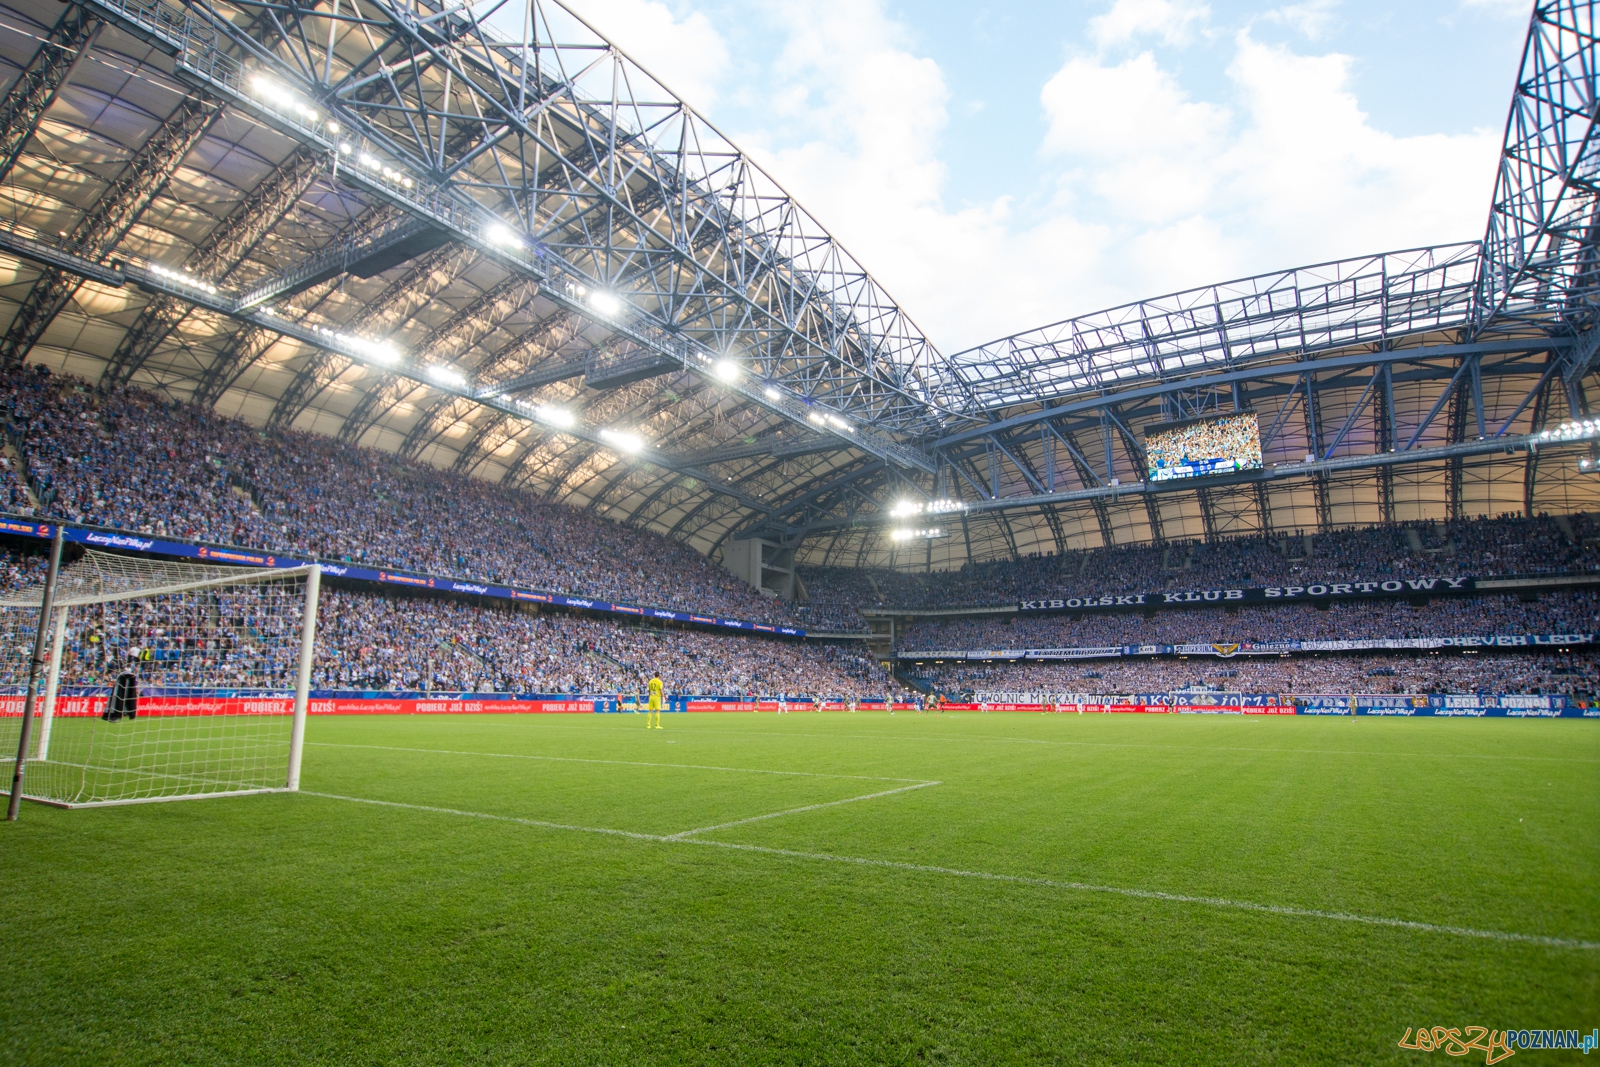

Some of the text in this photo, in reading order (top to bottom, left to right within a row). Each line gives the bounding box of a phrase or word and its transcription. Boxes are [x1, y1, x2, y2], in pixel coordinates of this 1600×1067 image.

[1020, 577, 1467, 611] KIBOLSKI KLUB SPORTOWY
[1534, 633, 1594, 645] LECH
[62, 699, 90, 713] JUŻ
[243, 701, 286, 713] POBIERZ
[310, 699, 336, 713] DZIŚ!
[415, 702, 447, 713] POBIERZ
[449, 701, 463, 712] JUŻ
[464, 701, 483, 712] DZIŚ!
[541, 703, 566, 712] POBIERZ
[1444, 697, 1481, 709] LECH
[1279, 705, 1295, 714] DZIŚ!
